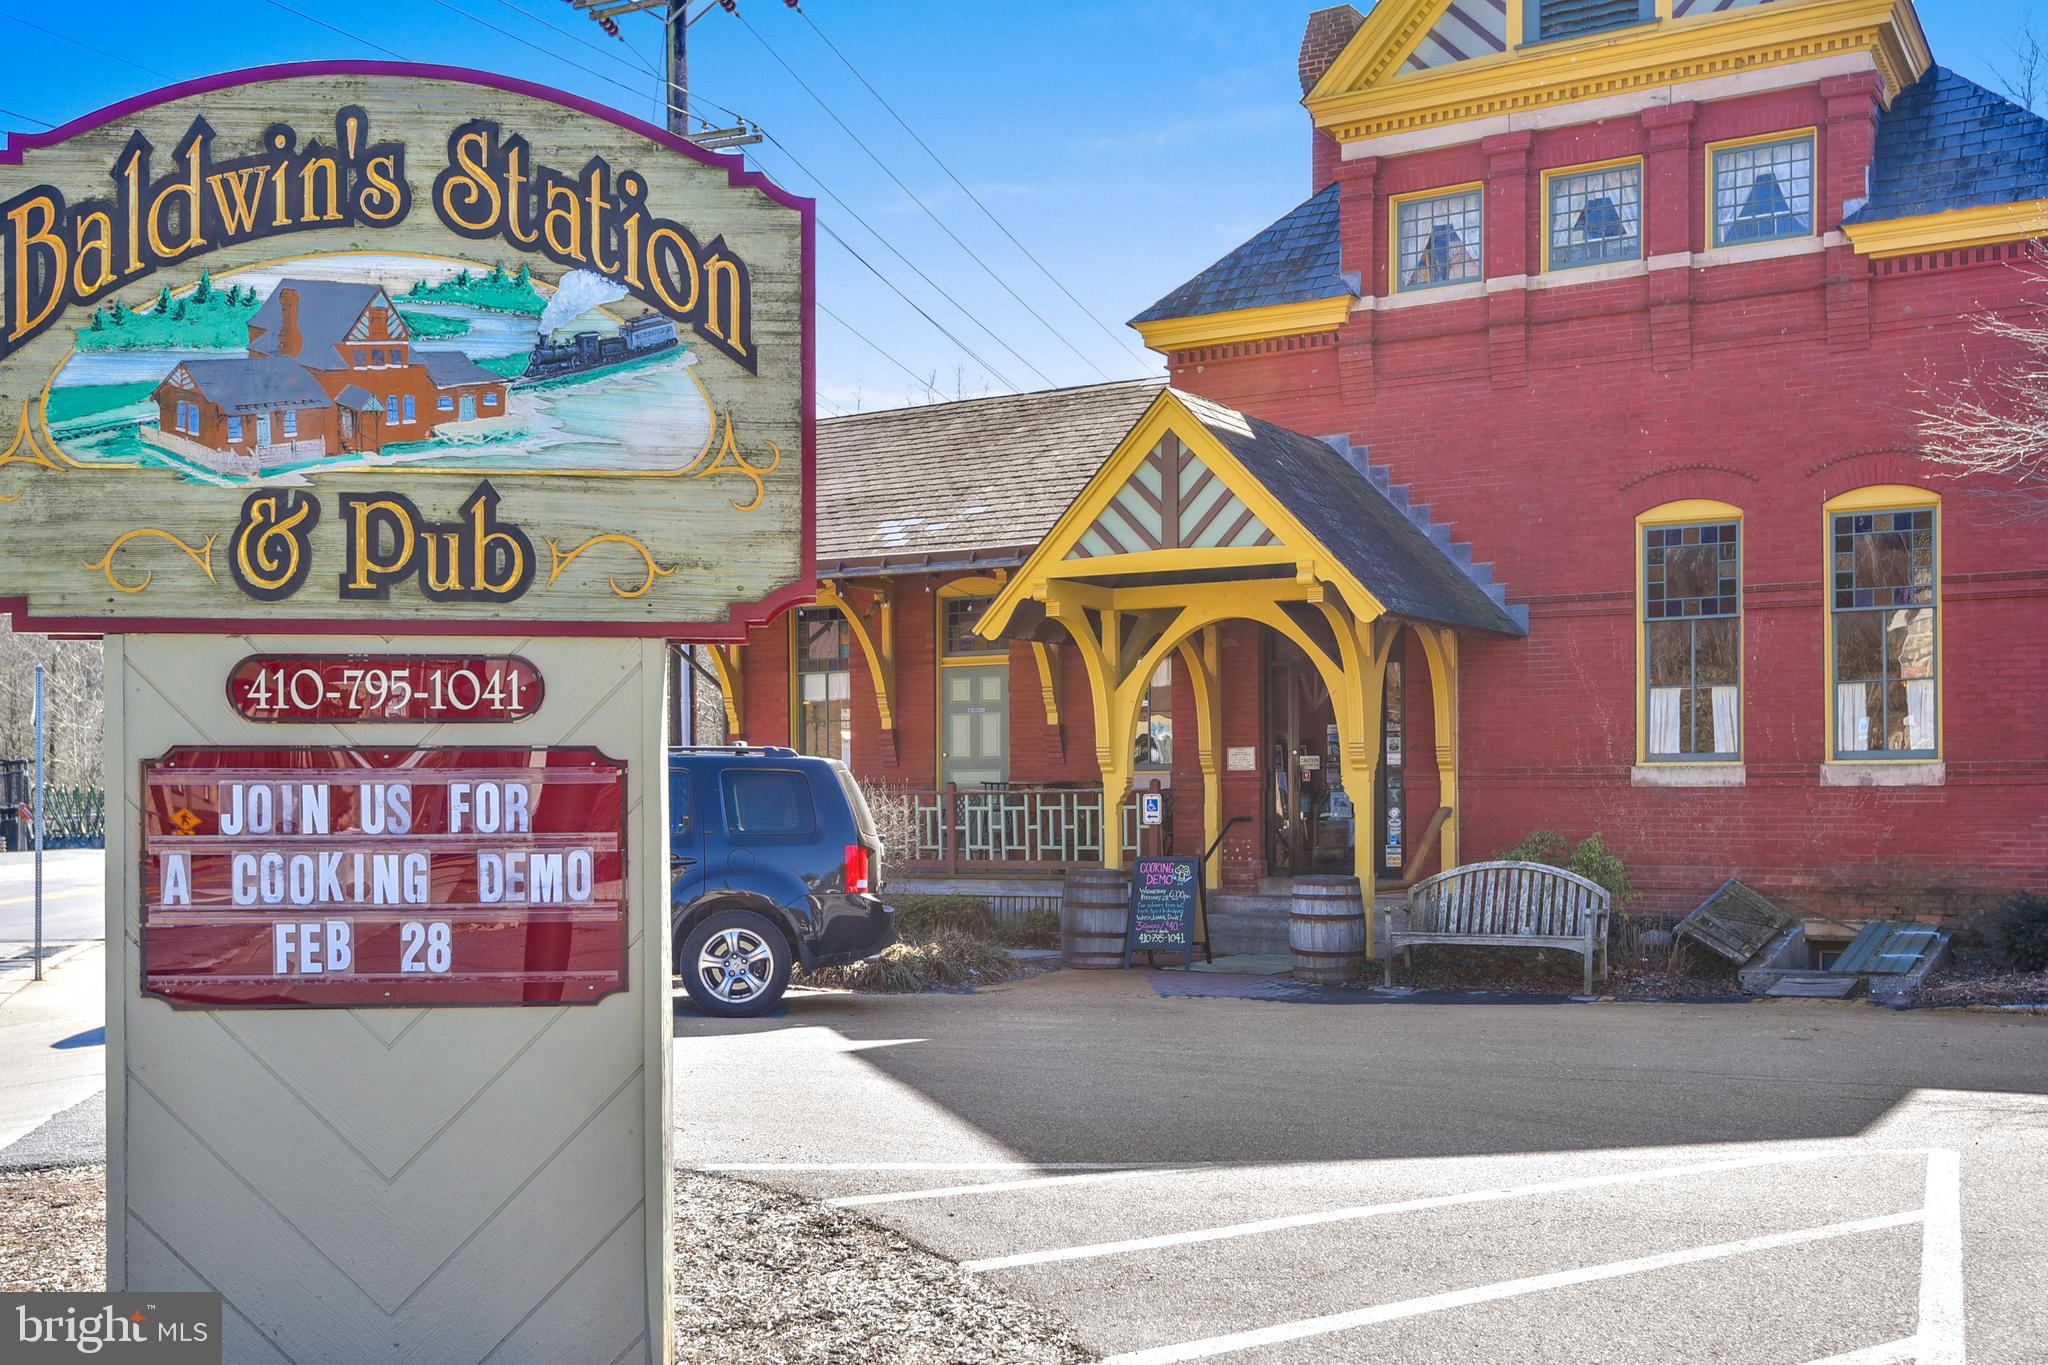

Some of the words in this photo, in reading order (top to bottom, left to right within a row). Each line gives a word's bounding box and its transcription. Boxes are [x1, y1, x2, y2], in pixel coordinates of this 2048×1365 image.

[5, 114, 405, 345] Baldwin's
[442, 129, 748, 358] Station
[235, 495, 311, 591] &
[347, 495, 525, 594] Pub
[246, 668, 524, 710] 410-795-1041
[220, 784, 329, 835] JOIN
[360, 783, 412, 835] US
[450, 782, 529, 834] FOR
[163, 853, 190, 905] A
[233, 851, 428, 905] COOKING
[479, 850, 592, 903] DEMO
[1140, 862, 1174, 873] COOKING
[1146, 874, 1173, 885] DEMO
[276, 920, 351, 974] FEB
[402, 921, 451, 973] 28
